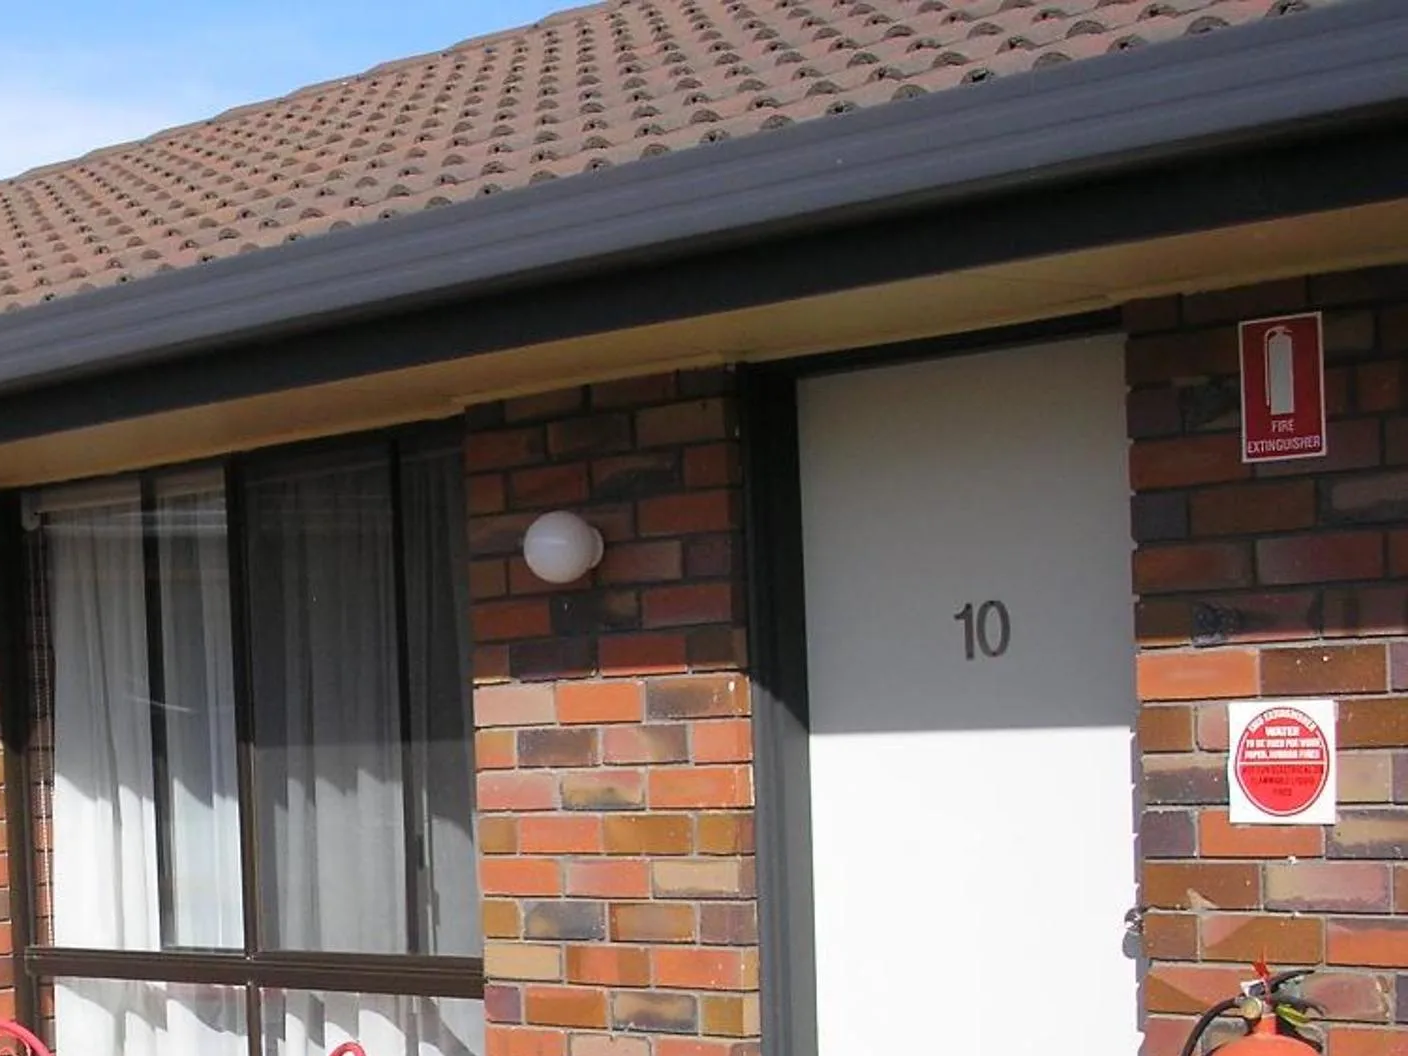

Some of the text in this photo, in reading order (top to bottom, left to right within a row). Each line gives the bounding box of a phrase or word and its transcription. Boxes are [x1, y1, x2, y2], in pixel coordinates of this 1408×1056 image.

[1271, 419, 1295, 433] FIRE
[1247, 435, 1321, 454] EXTINGUISHER
[953, 600, 1011, 661] 10
